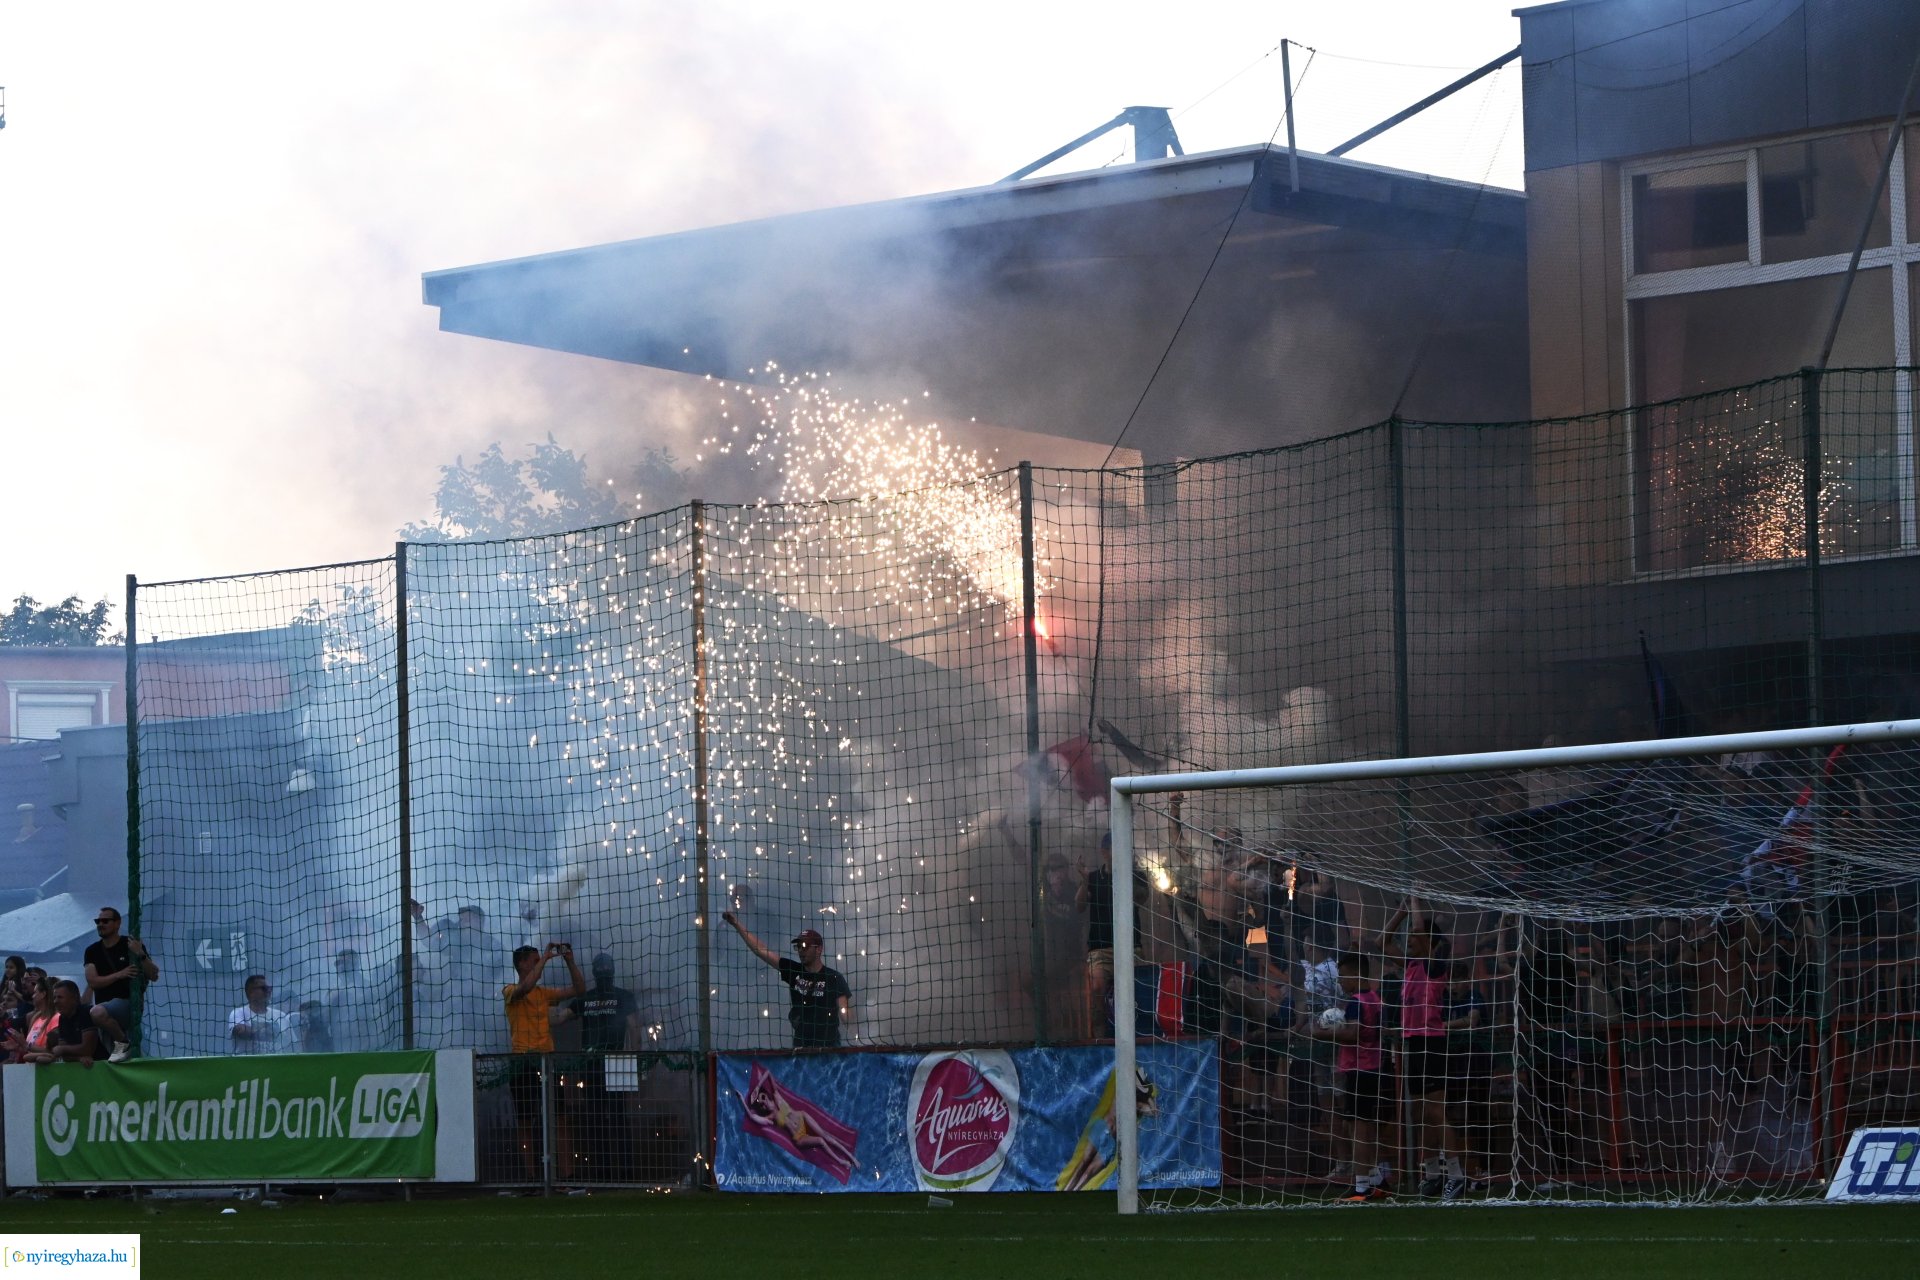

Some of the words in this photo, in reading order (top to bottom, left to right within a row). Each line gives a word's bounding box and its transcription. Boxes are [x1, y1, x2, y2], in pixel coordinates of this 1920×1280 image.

[87, 1076, 347, 1142] merkantilbank
[358, 1087, 423, 1124] LIGA
[914, 1086, 1008, 1172] Aquarius
[947, 1129, 1005, 1141] NYÍREGYHÁZA
